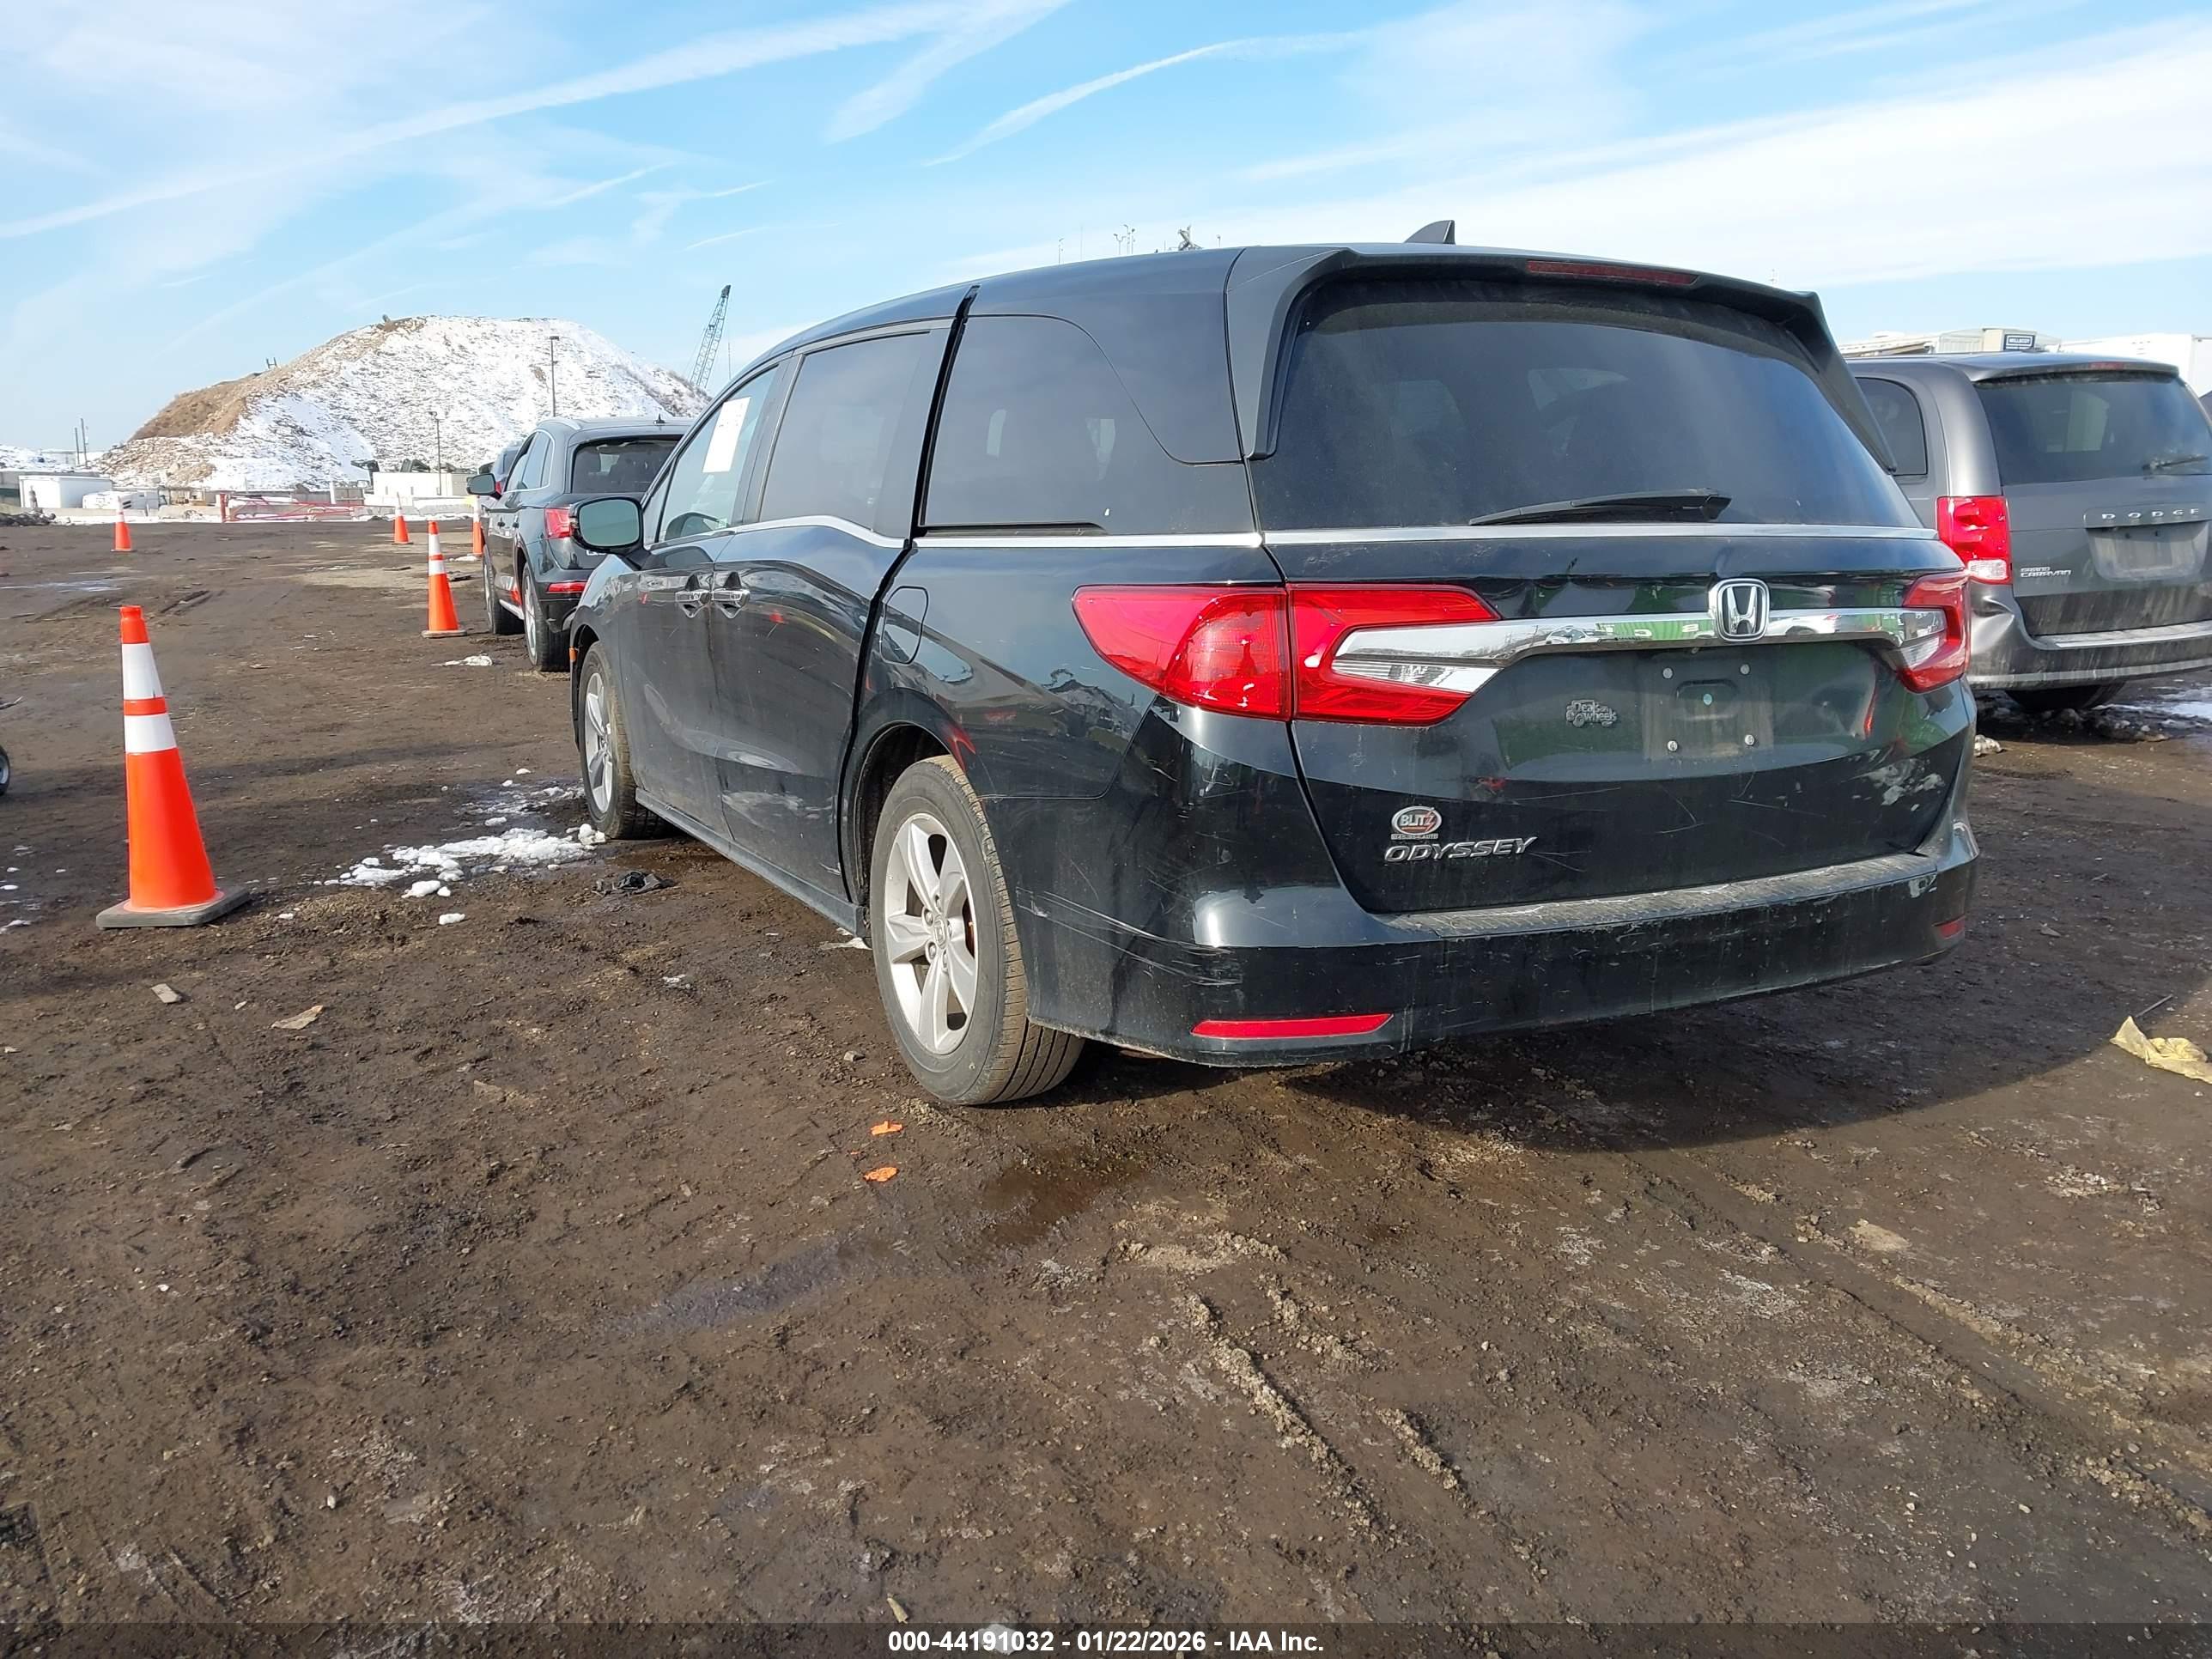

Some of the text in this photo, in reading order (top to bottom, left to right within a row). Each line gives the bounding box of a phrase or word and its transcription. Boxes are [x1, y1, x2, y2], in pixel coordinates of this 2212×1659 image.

[2101, 507, 2199, 520] DODGE
[2021, 569, 2072, 578] CARAVAN
[1400, 813, 1436, 826] BLITZ
[1384, 836, 1538, 862] ODYSSEY
